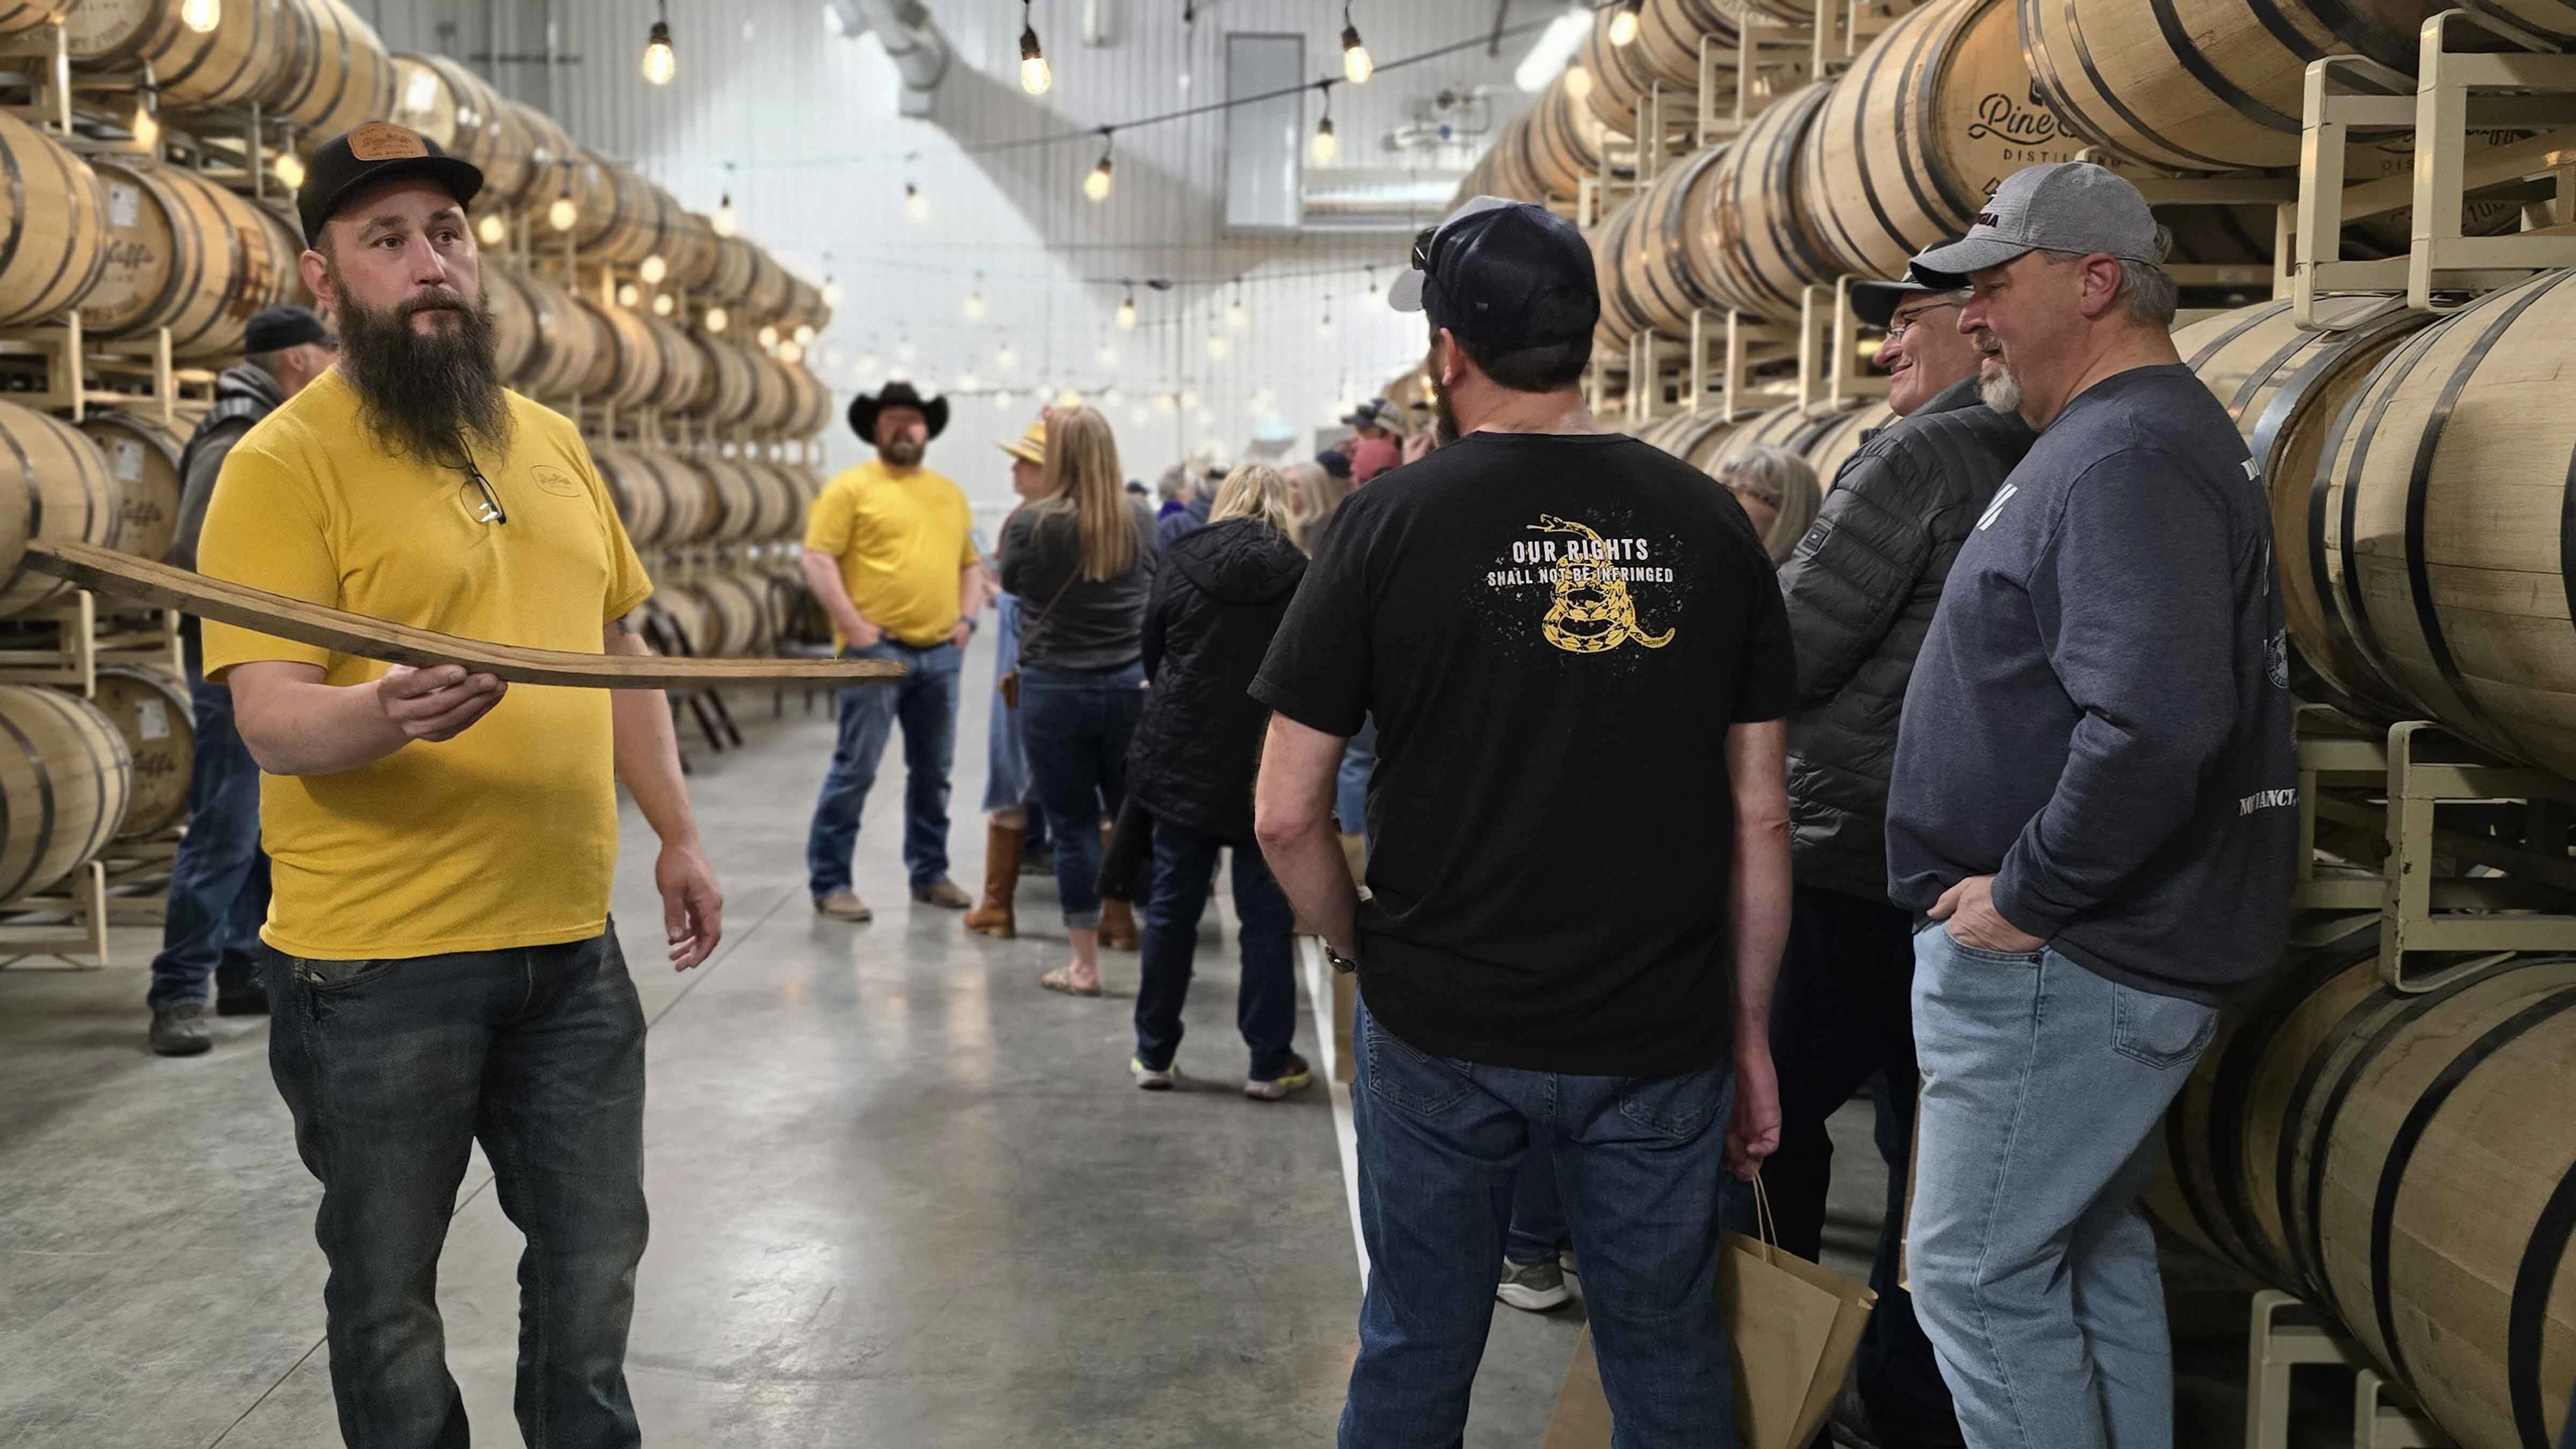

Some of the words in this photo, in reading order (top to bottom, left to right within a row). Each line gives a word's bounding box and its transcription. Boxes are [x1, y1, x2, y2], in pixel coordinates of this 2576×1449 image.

[1968, 93, 2056, 145] Pine
[1512, 540, 1557, 564] OUR
[1567, 538, 1649, 561] RIGHTS
[1487, 569, 1533, 587] SHALL
[1538, 567, 1566, 585] NOT
[1573, 566, 1591, 582] BE
[1597, 566, 1674, 583] INFRINGED
